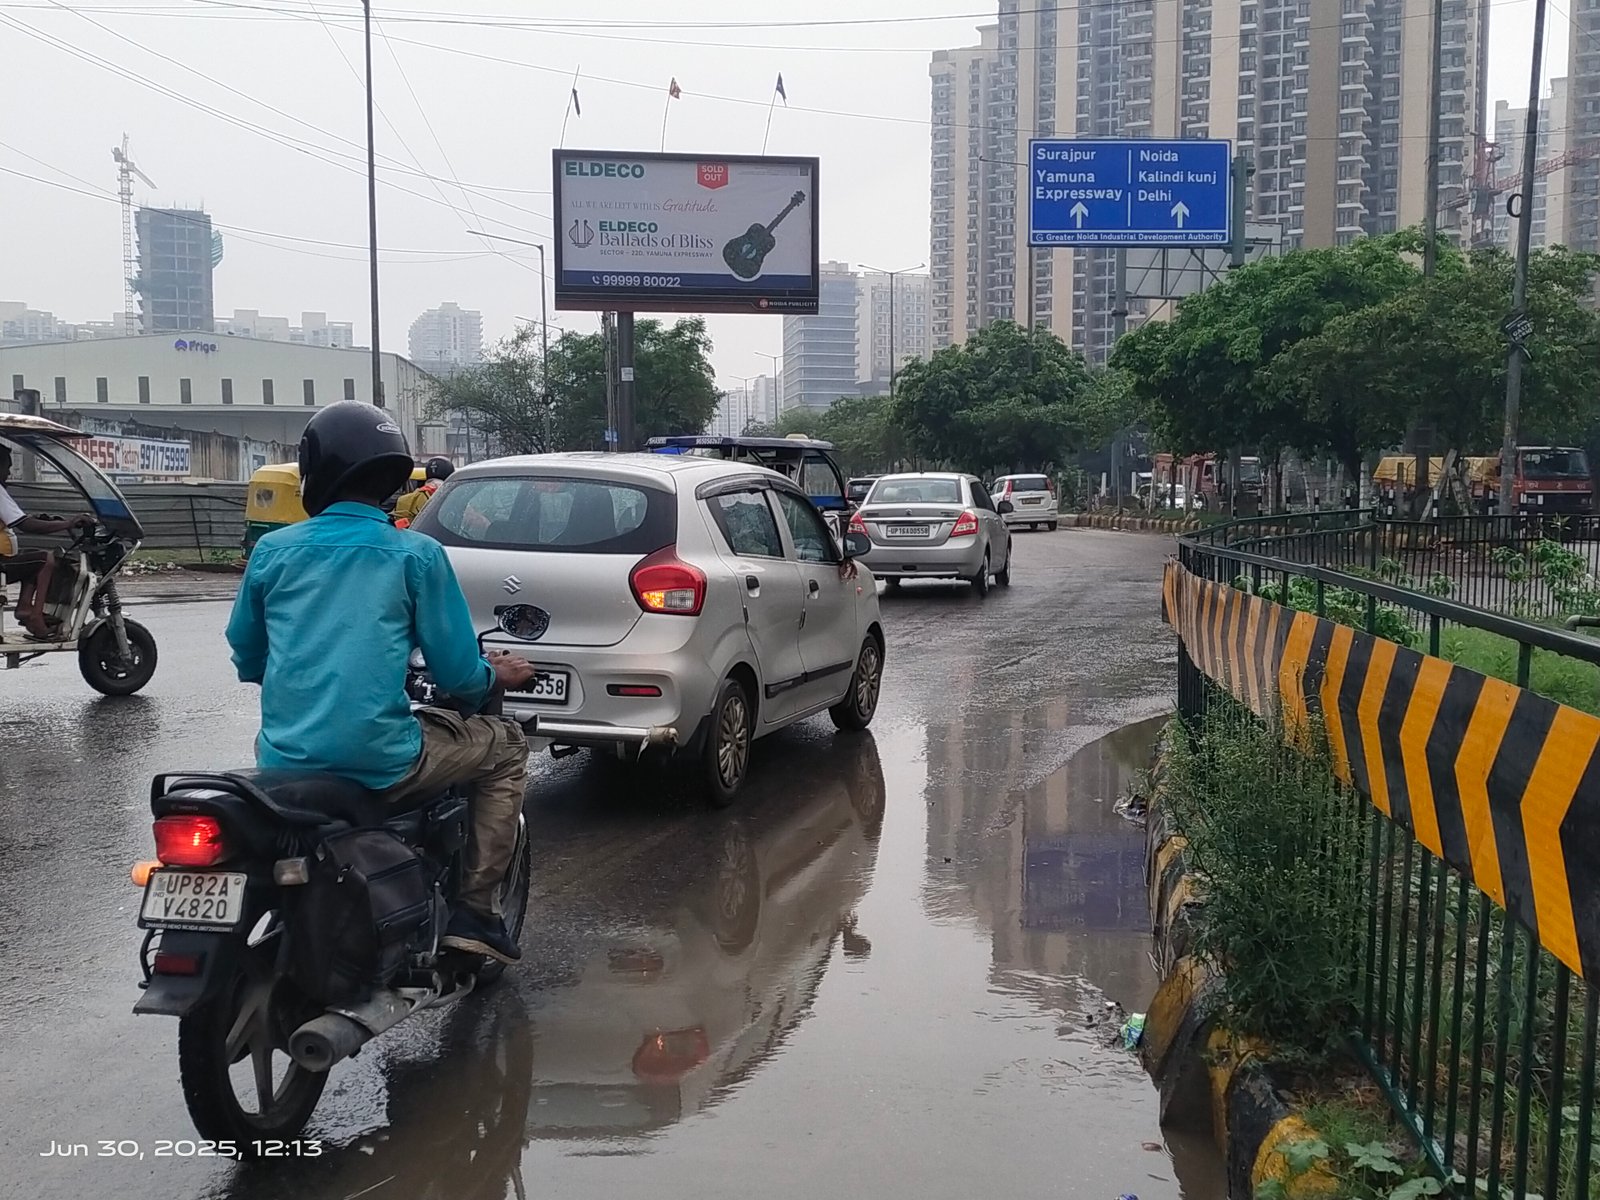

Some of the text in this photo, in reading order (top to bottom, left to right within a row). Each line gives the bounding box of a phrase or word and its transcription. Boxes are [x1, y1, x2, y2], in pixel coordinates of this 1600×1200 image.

[1036, 148, 1096, 163] Surajpur
[1140, 150, 1178, 162] Noida
[565, 161, 645, 179] ELDECO
[701, 165, 724, 173] SOLD
[1036, 169, 1095, 183] Yamuna
[703, 173, 722, 181] OUT
[1138, 170, 1217, 185] Kalindi kunj
[1035, 186, 1123, 202] Expressway
[1138, 189, 1172, 202] Delhi
[599, 220, 659, 234] ELDECO
[600, 232, 714, 249] Ballads of Bliss
[1046, 233, 1074, 241] Greater
[1139, 233, 1186, 242] Development
[1188, 233, 1223, 242] Authority
[674, 250, 713, 258] EXPRESSWAY
[602, 275, 681, 288] 99999 80022
[165, 874, 230, 897] UP82A
[162, 897, 229, 920] V4820
